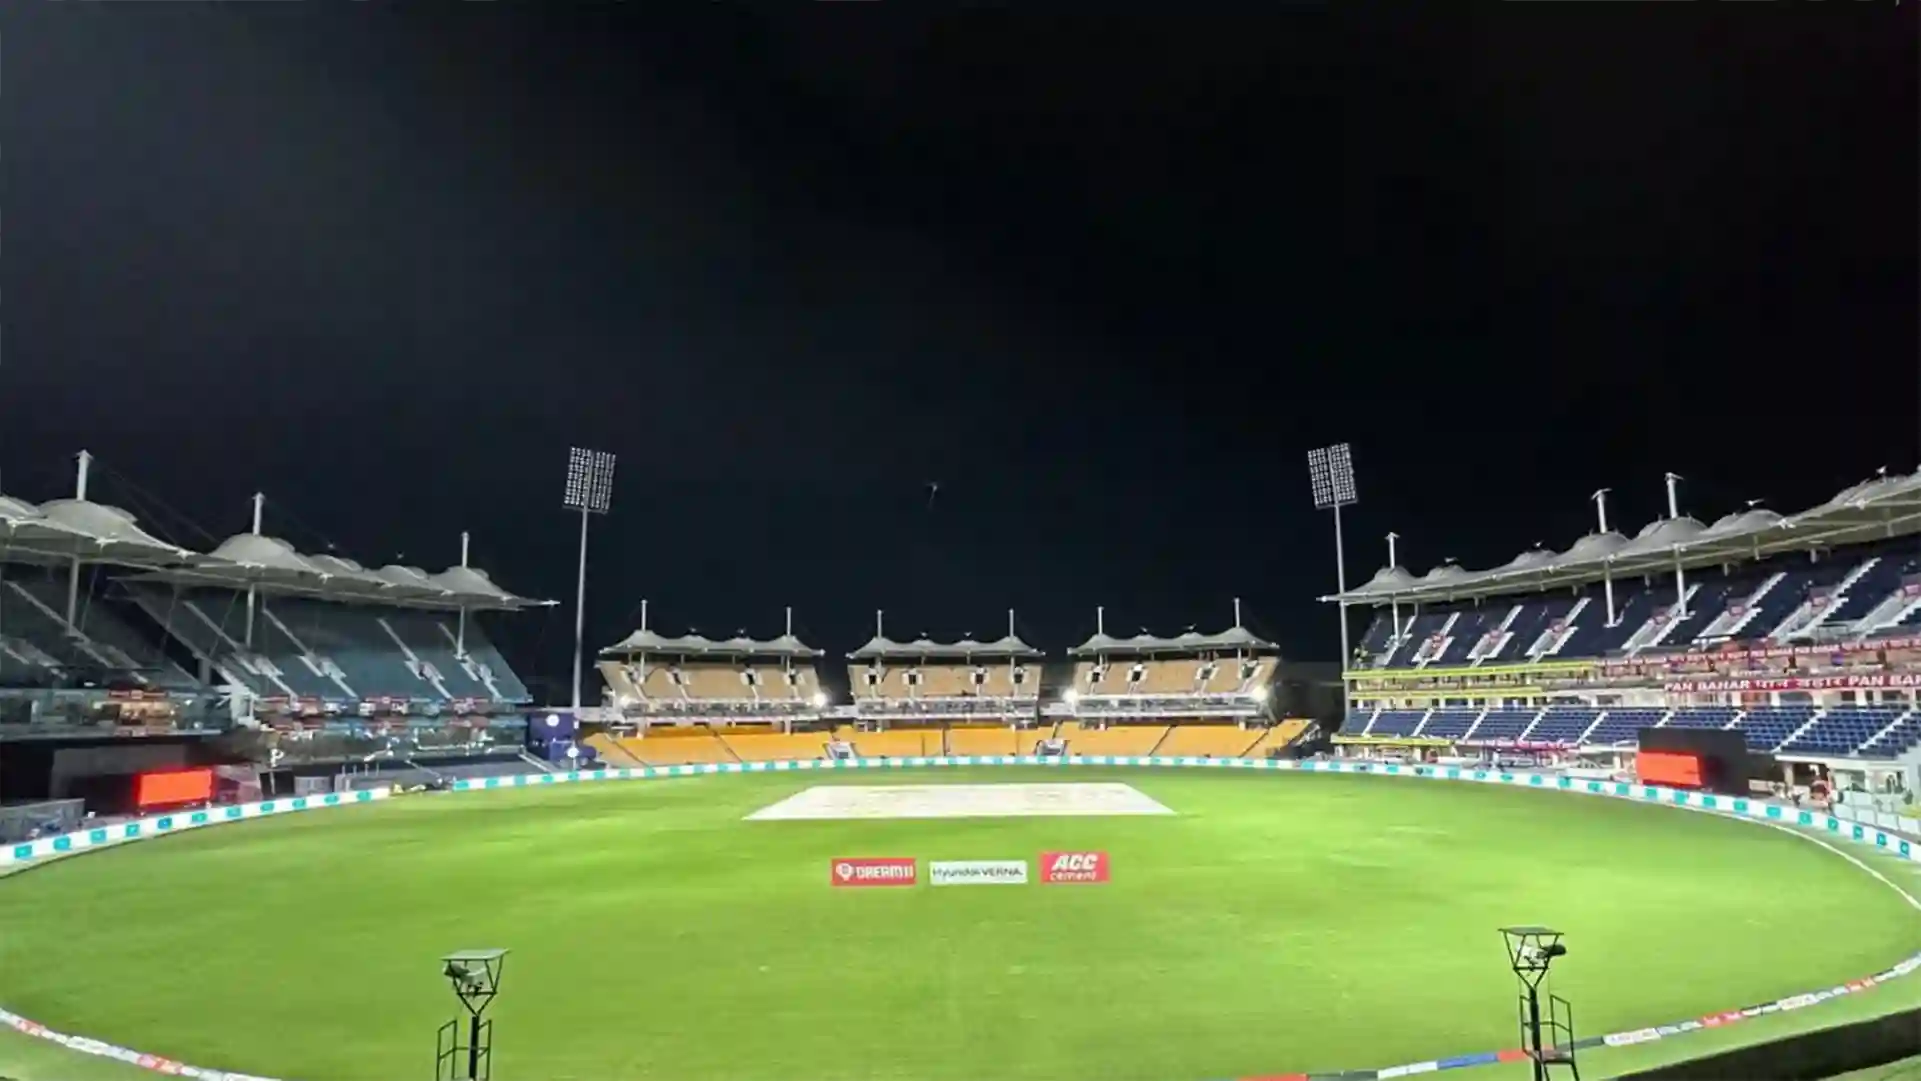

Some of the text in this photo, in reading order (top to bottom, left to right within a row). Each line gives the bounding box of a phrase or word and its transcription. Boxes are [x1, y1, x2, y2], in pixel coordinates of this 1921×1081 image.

[1664, 681, 1693, 691] PAN
[1697, 679, 1750, 690] BAHAR
[1848, 674, 1884, 686] PAN
[1051, 854, 1098, 870] ACC
[1050, 871, 1097, 881] cement
